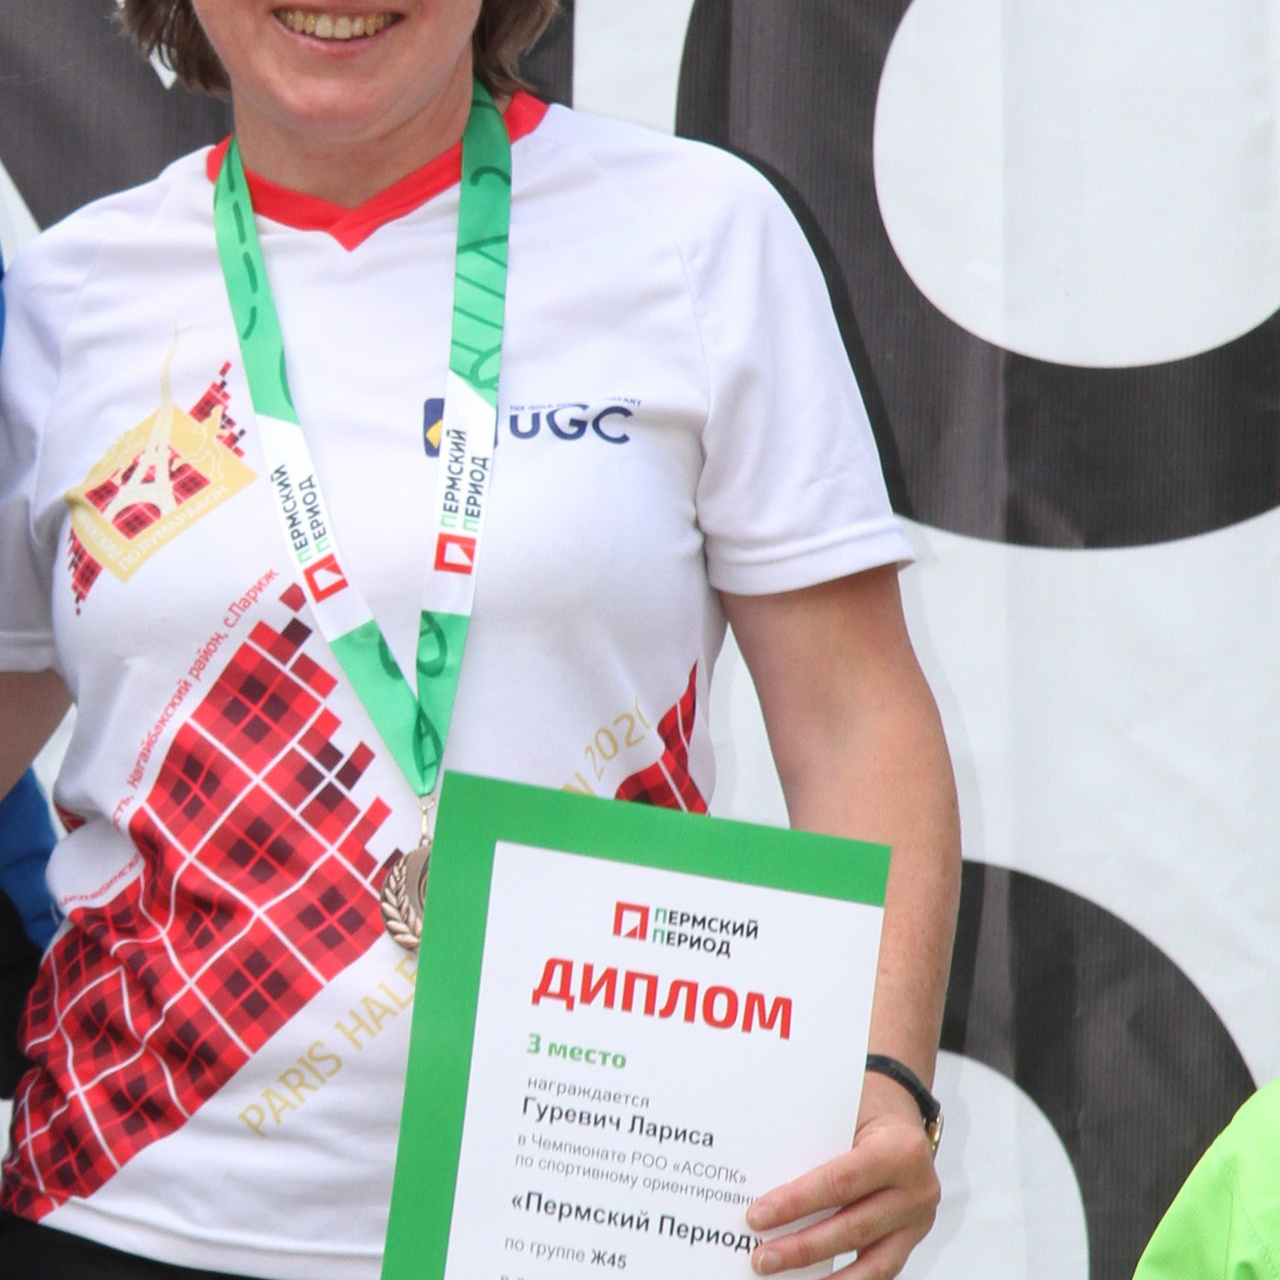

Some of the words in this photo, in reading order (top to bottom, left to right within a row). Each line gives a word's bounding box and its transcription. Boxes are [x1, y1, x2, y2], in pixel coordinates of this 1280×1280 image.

[510, 404, 634, 445] UGC
[440, 429, 467, 528] ПЕРМСКИЙ
[462, 456, 490, 533] ПЕРИОД
[270, 464, 313, 564] ПЕРМСКИЙ
[299, 475, 331, 554] ПЕРИОД
[126, 678, 193, 789] Нагайбакский
[652, 928, 731, 959] ПЕРИОД
[654, 907, 759, 940] ПЕРМСКИЙ
[531, 957, 793, 1040] ДИПЛОМ
[526, 1033, 541, 1054] 3
[548, 1041, 626, 1069] место
[238, 1040, 343, 1138] PARIS
[527, 1077, 650, 1108] награждается
[522, 1095, 621, 1132] Гуревич
[628, 1114, 714, 1147] Лариса
[515, 1154, 533, 1167] по
[538, 1156, 638, 1189] спортивному
[642, 1176, 760, 1208] ориентирован
[517, 1134, 526, 1146] в
[532, 1134, 626, 1163] Чемпионате
[631, 1151, 668, 1171] РОО
[673, 1160, 747, 1184] «АСОПК»
[511, 1190, 650, 1233] «Пермский
[658, 1215, 765, 1253] Период»
[504, 1237, 524, 1253] по
[529, 1240, 586, 1265] группе
[589, 1249, 627, 1270] Ж45
